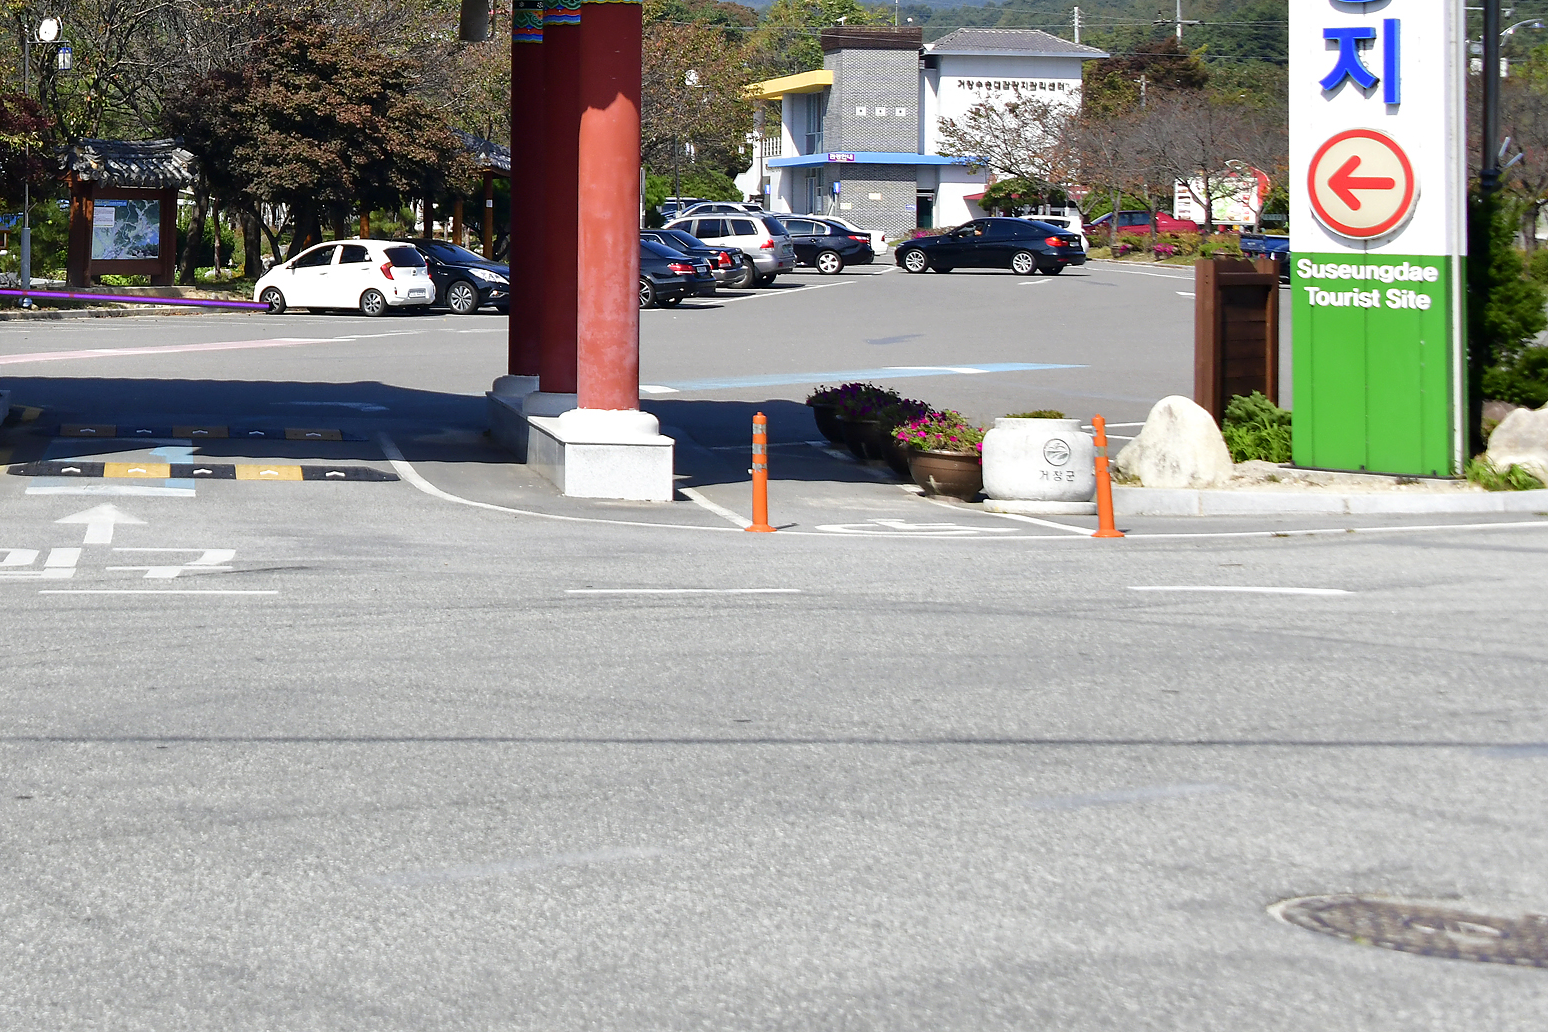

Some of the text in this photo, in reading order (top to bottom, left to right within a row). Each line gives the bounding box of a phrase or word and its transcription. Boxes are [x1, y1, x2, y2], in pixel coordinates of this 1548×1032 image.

[1296, 258, 1439, 284] Suseungdae
[1303, 286, 1432, 311] Tourist Site
[1039, 469, 1075, 482] 거창군
